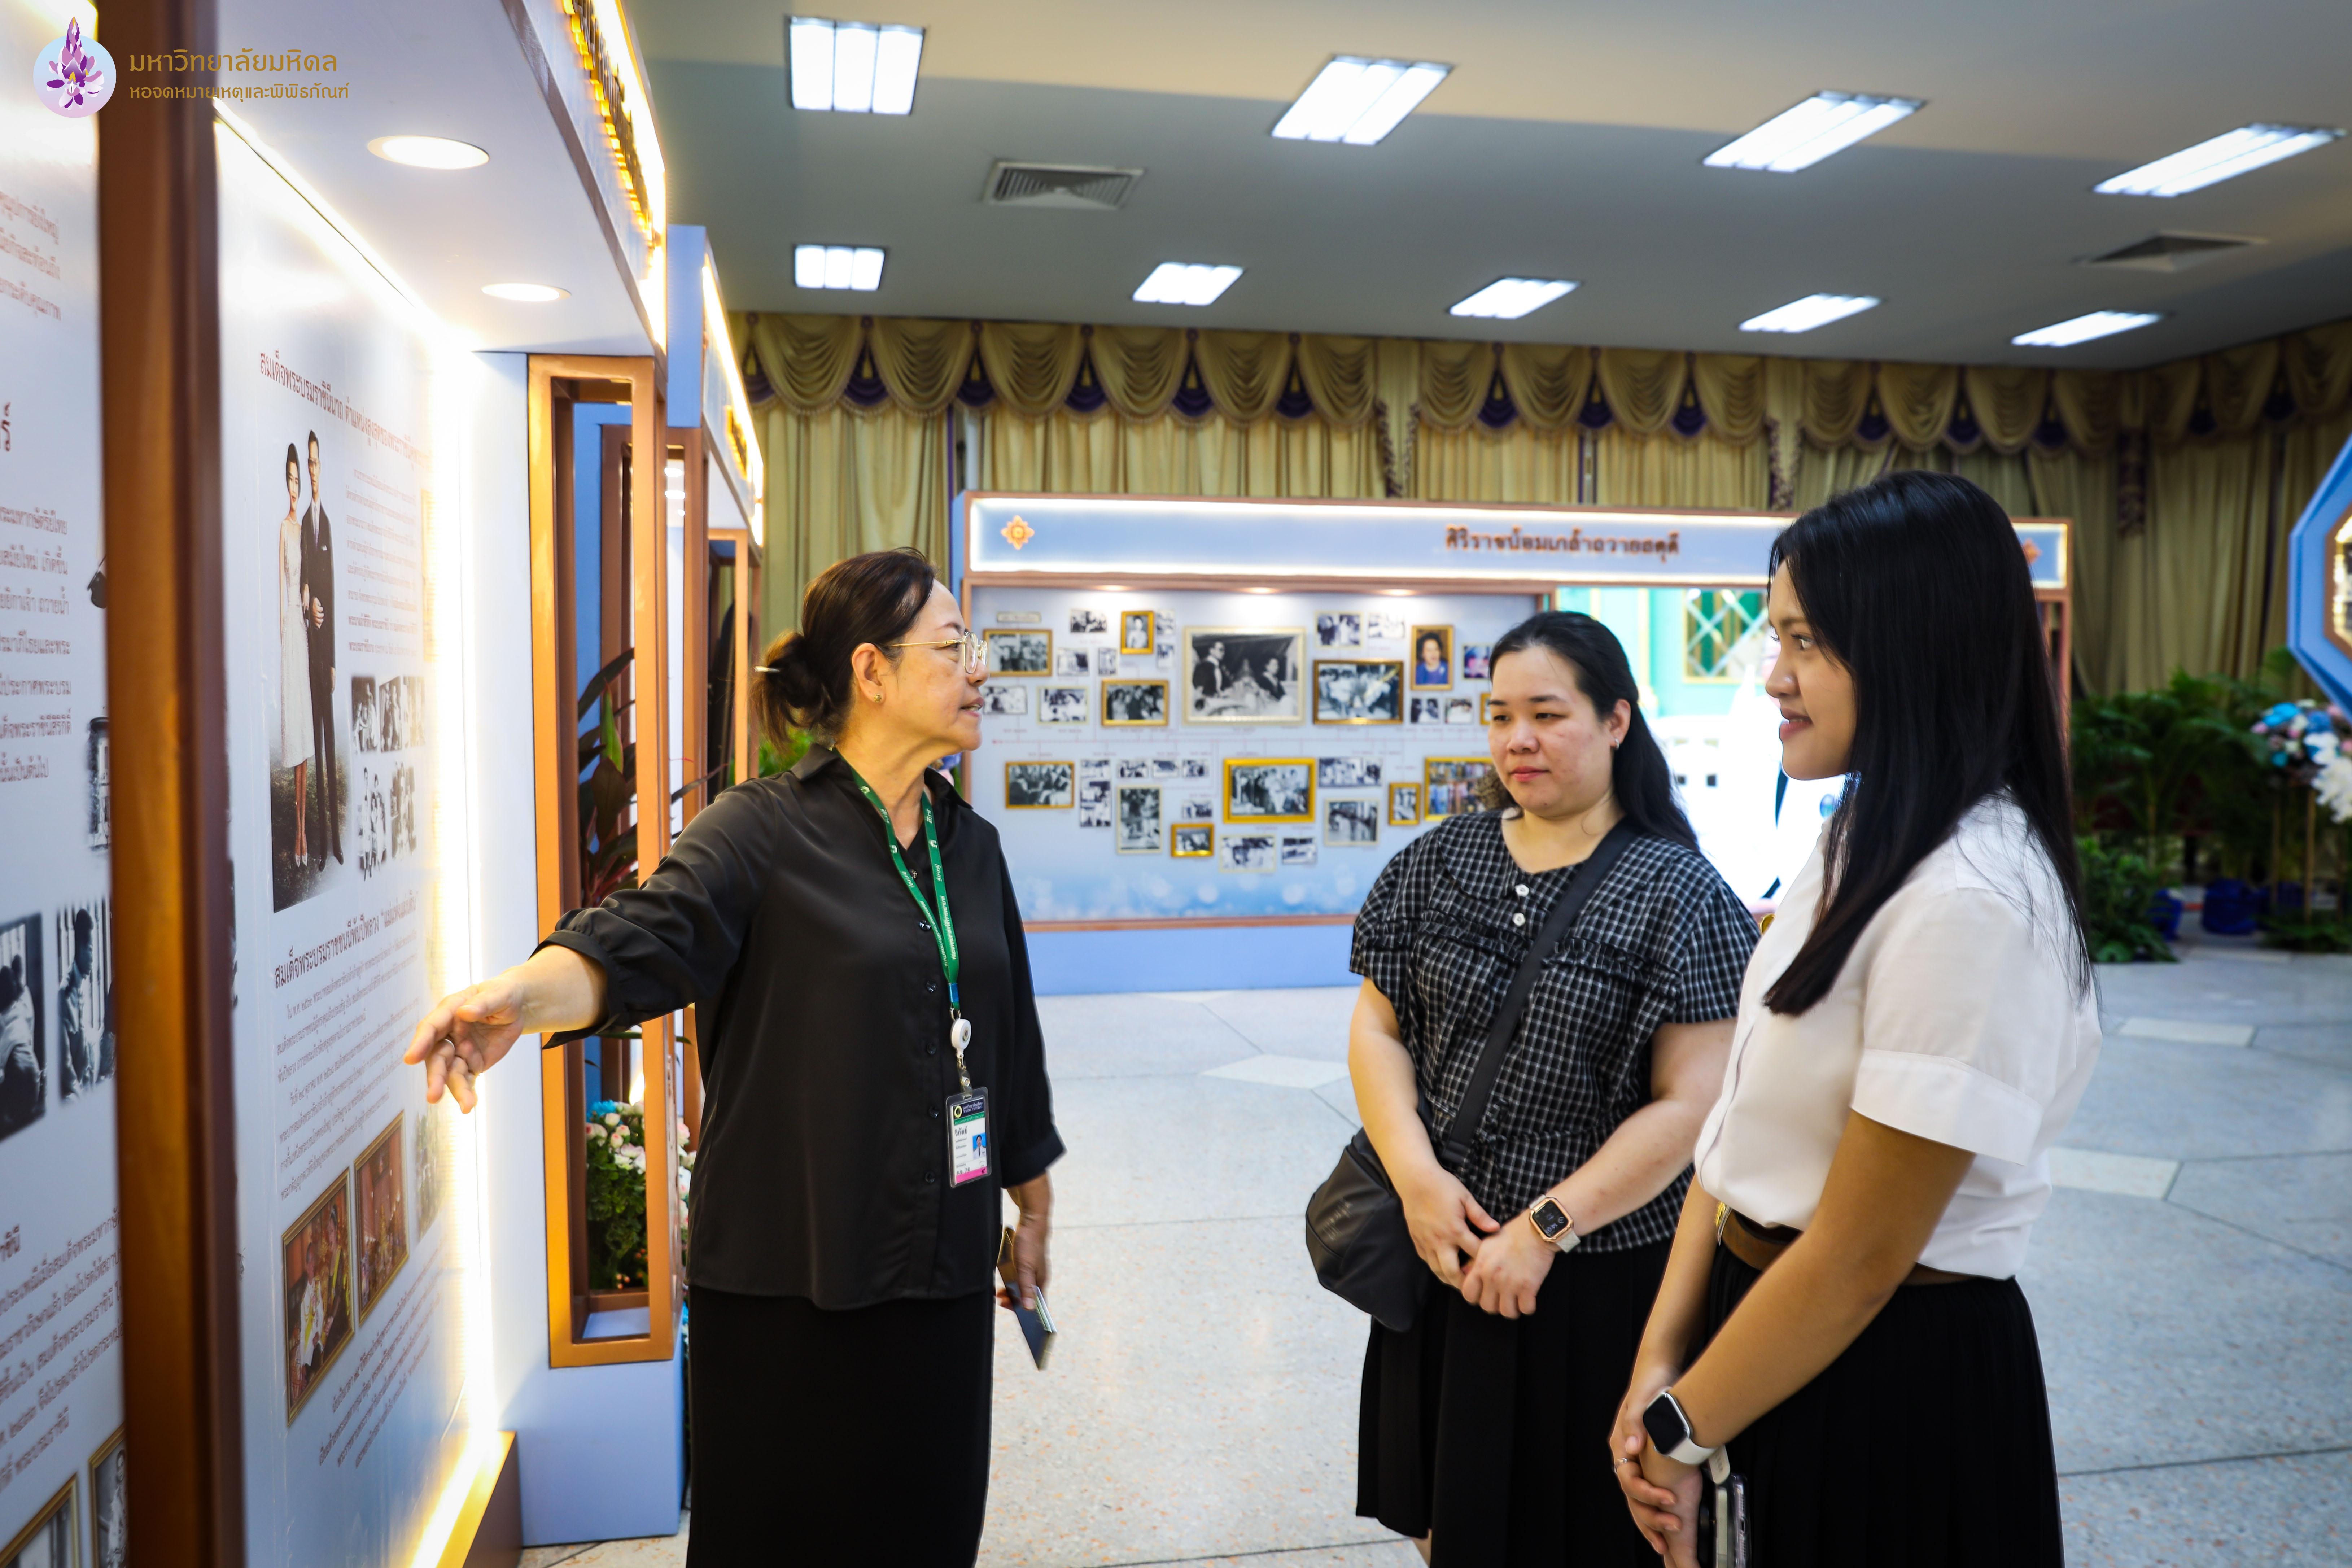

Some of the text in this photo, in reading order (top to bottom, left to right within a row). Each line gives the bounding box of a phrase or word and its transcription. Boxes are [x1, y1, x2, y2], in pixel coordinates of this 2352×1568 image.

[260, 349, 343, 420] สมเด็จพระบรมราชินีนาถ
[0, 401, 11, 452] ร์
[275, 913, 380, 989] สมเด็จพระบรมราชชนนีพันปีหลวง
[63, 1246, 122, 1308] ย่อมโปรดให้สถาป
